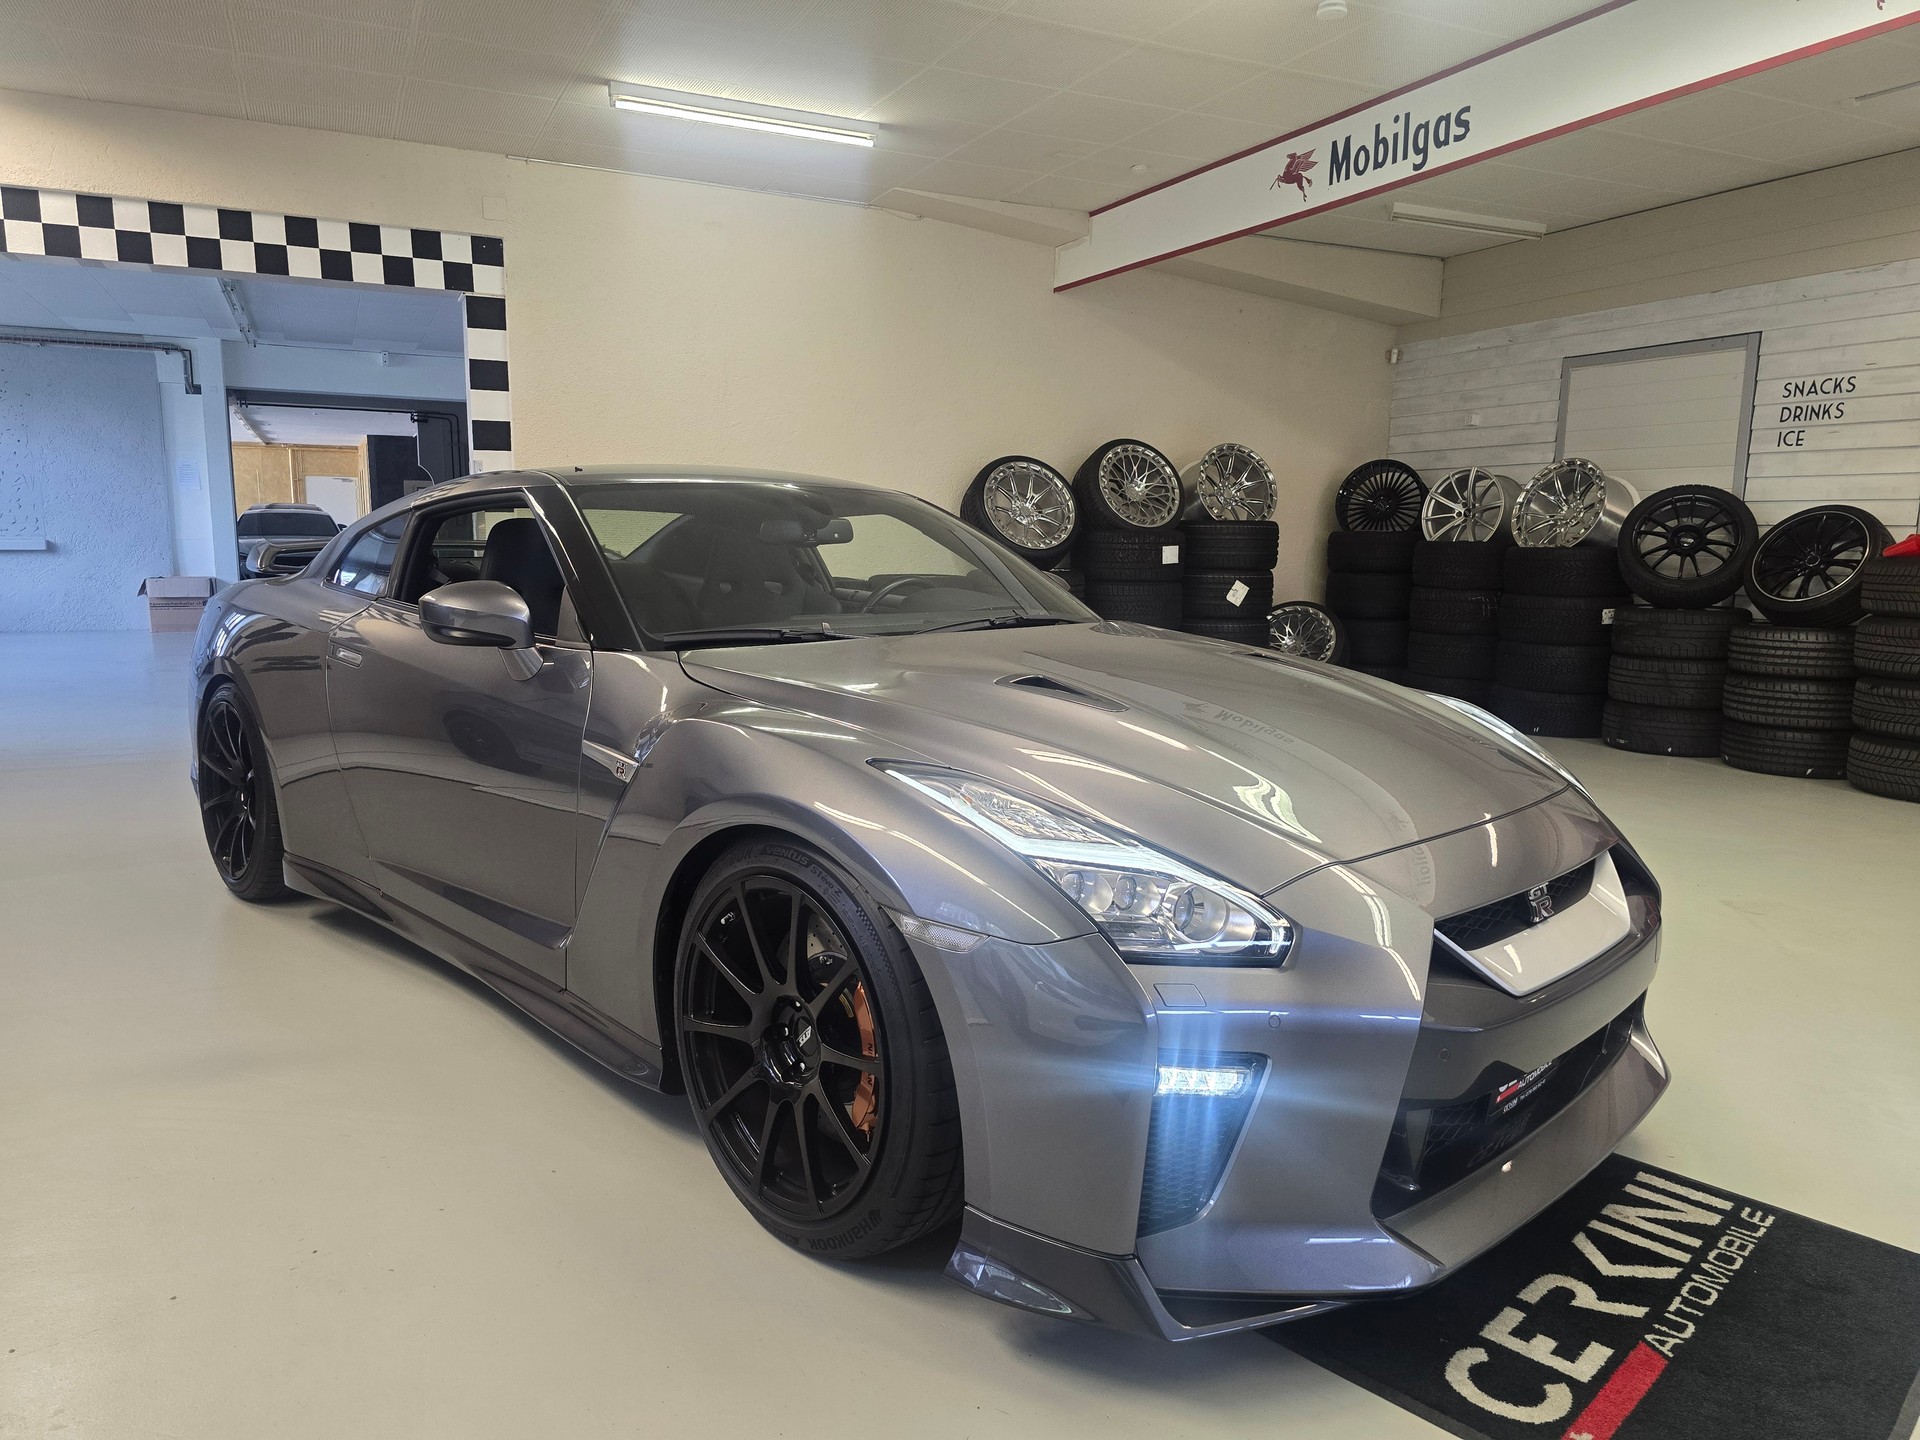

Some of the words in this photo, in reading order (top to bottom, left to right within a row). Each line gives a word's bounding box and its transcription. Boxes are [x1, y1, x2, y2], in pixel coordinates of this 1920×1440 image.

[1328, 105, 1471, 187] Mobilgas
[1779, 402, 1845, 423] DRINKS
[1782, 375, 1857, 399] SNACKS
[1777, 430, 1806, 448] ICE
[1444, 1171, 1735, 1424] CERKINI
[1644, 1206, 1776, 1358] AUTOMOBILE
